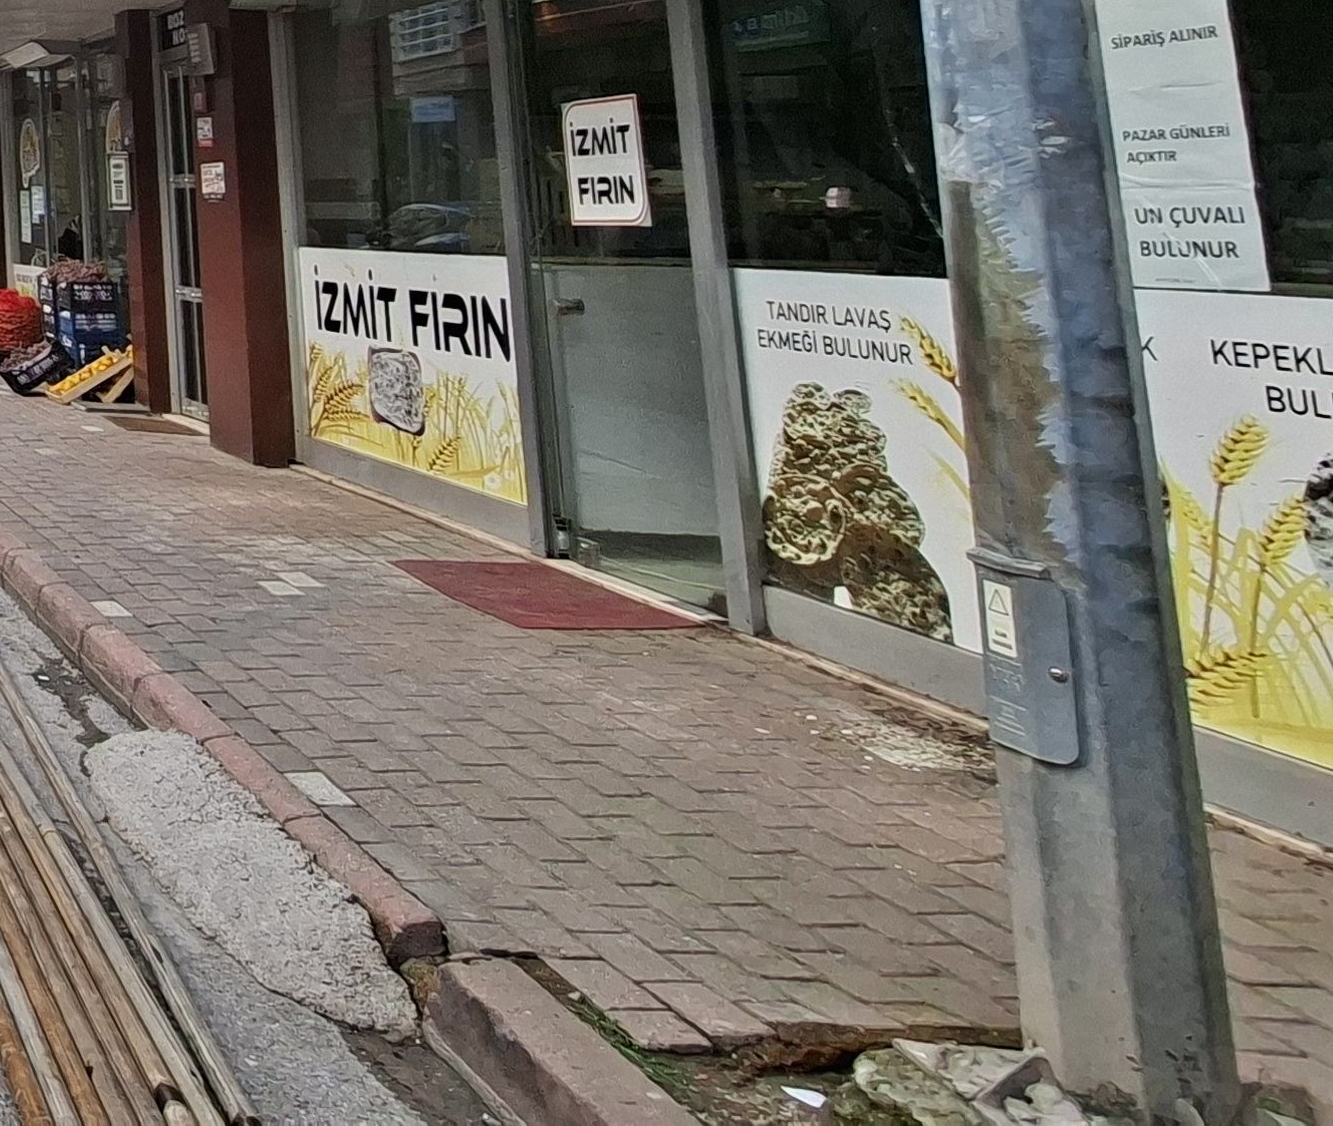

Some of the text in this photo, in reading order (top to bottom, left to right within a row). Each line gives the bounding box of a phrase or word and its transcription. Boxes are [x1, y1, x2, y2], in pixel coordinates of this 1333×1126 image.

[1110, 25, 1219, 50] SİPARİŞ ALINIR
[569, 117, 631, 157] İZMİT
[1122, 122, 1231, 142] PAZAR GÜNLERİ
[1126, 150, 1178, 165] AÇIKTIR
[577, 174, 636, 205] FIRIN
[1133, 206, 1246, 228] UN ÇUVALI
[1139, 239, 1240, 259] BULUNUR
[313, 264, 512, 363] İZMİT FIRIN
[765, 300, 892, 334] TANDIR LAVAŞ
[756, 328, 914, 366] EKMEĞİ BULUNUR
[1265, 384, 1333, 420] BUL
